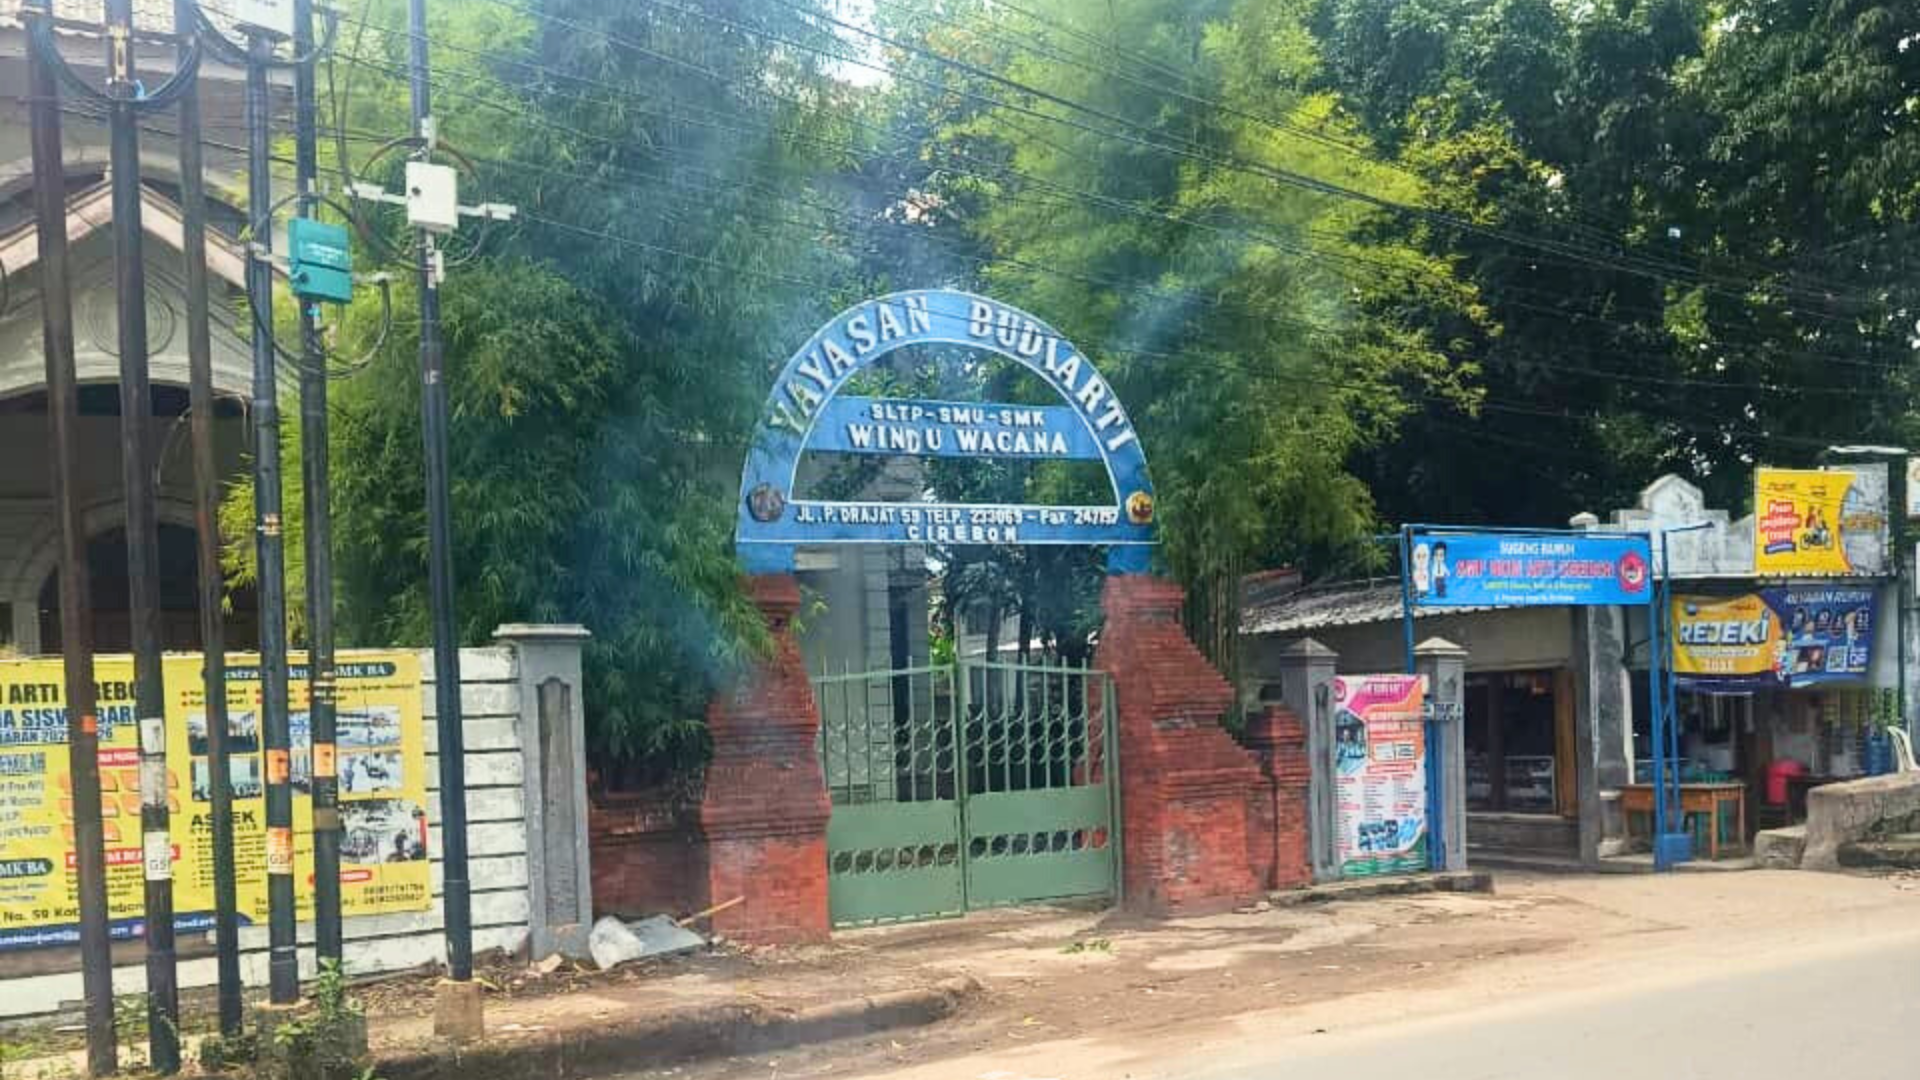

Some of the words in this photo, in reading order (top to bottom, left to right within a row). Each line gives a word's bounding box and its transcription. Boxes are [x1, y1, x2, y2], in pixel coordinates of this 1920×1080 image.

[770, 296, 930, 434] YAYASAN
[849, 424, 942, 453] WINDU
[957, 429, 1068, 453] WACANA
[841, 507, 894, 523] DRAJAT
[908, 525, 1017, 541] CIREBON
[1679, 611, 1768, 644] REJEKI
[9, 684, 59, 704] ARTI
